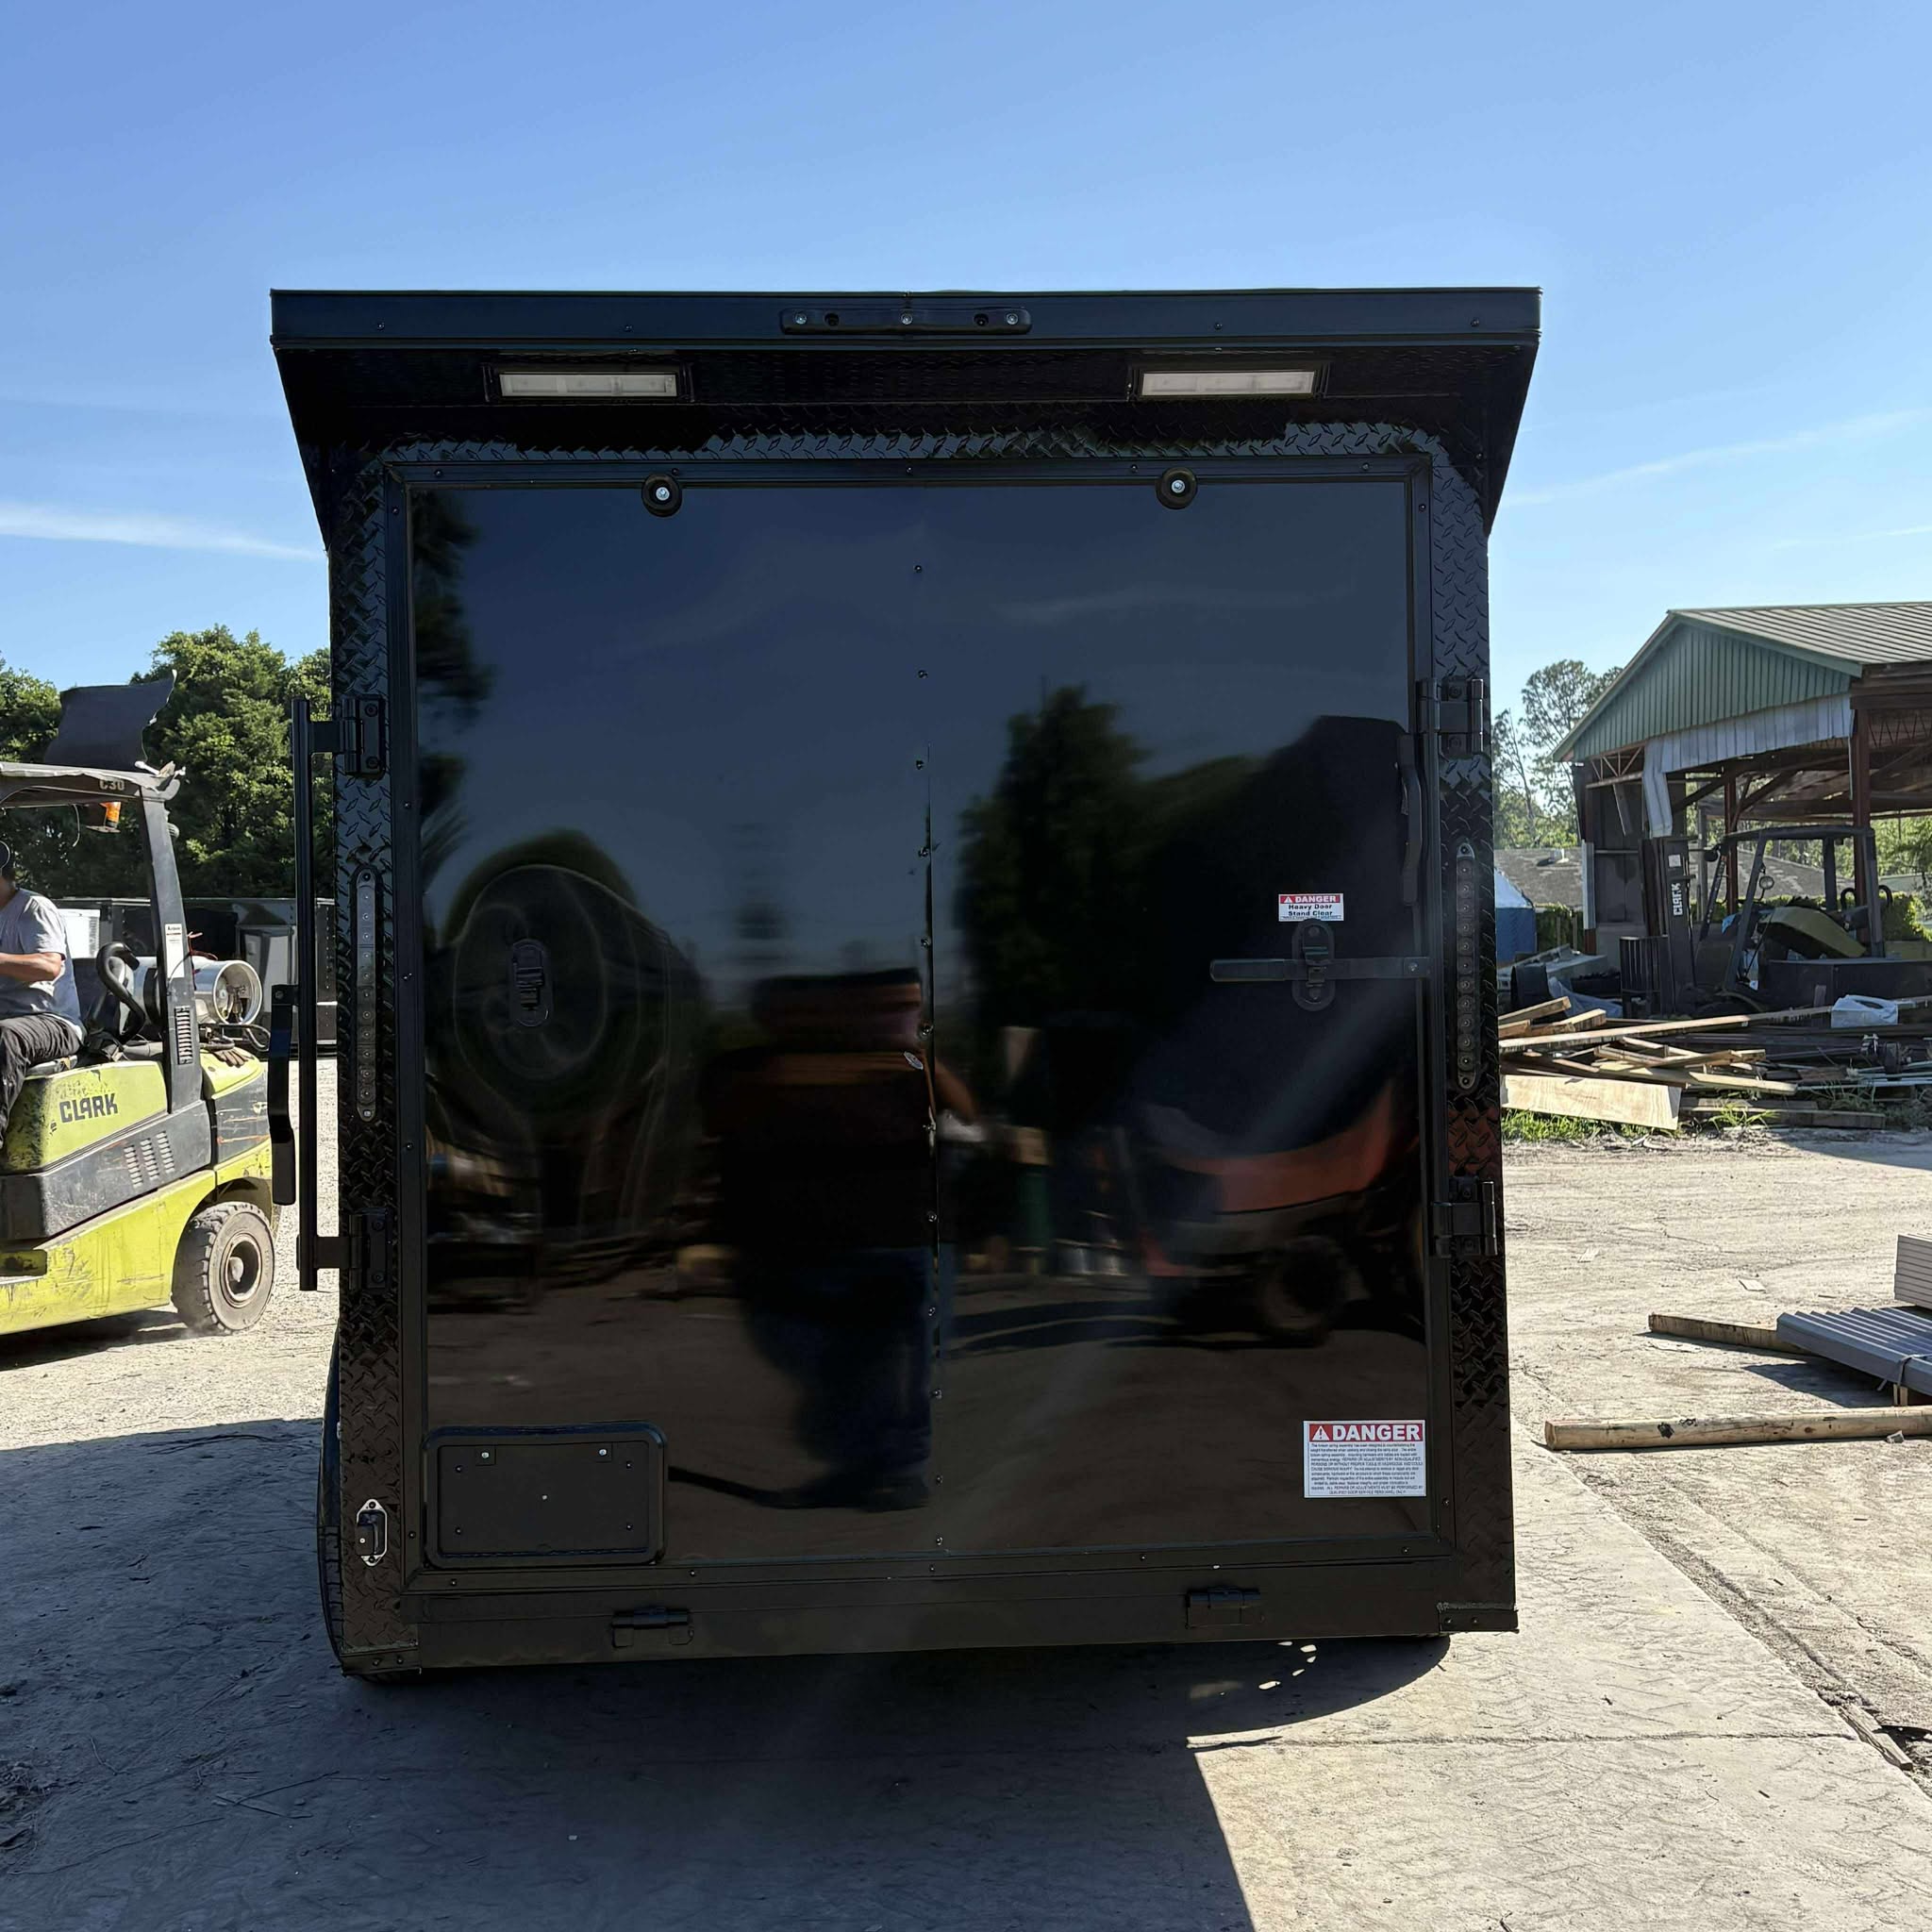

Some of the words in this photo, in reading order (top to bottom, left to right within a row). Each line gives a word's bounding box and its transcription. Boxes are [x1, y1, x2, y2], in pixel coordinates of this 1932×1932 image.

[99, 778, 125, 791] C30
[1295, 895, 1336, 904] DANGER
[1671, 882, 1683, 916] CLARK
[59, 1092, 118, 1123] CLARK
[1332, 1424, 1421, 1441] DANGER
